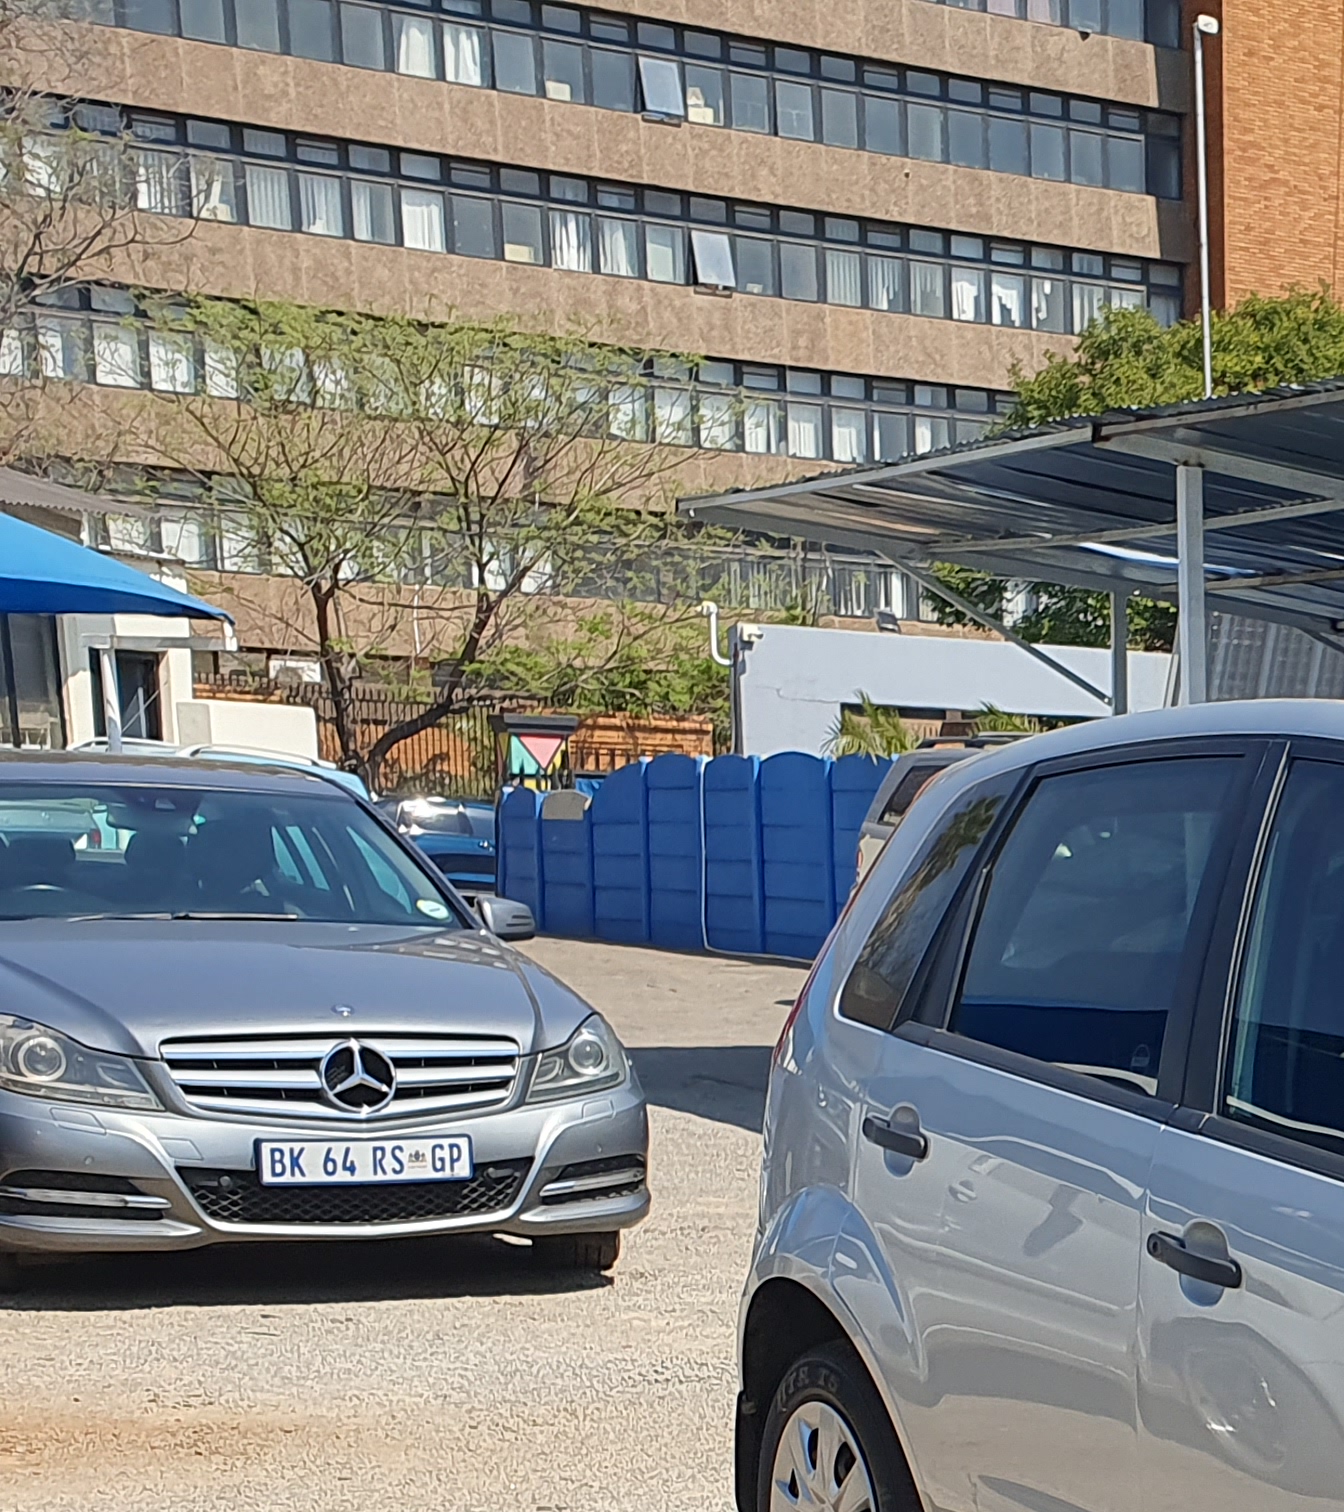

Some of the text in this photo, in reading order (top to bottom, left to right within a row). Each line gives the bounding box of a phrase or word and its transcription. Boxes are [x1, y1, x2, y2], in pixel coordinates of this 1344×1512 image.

[269, 1143, 463, 1178] BK 64 RS GP
